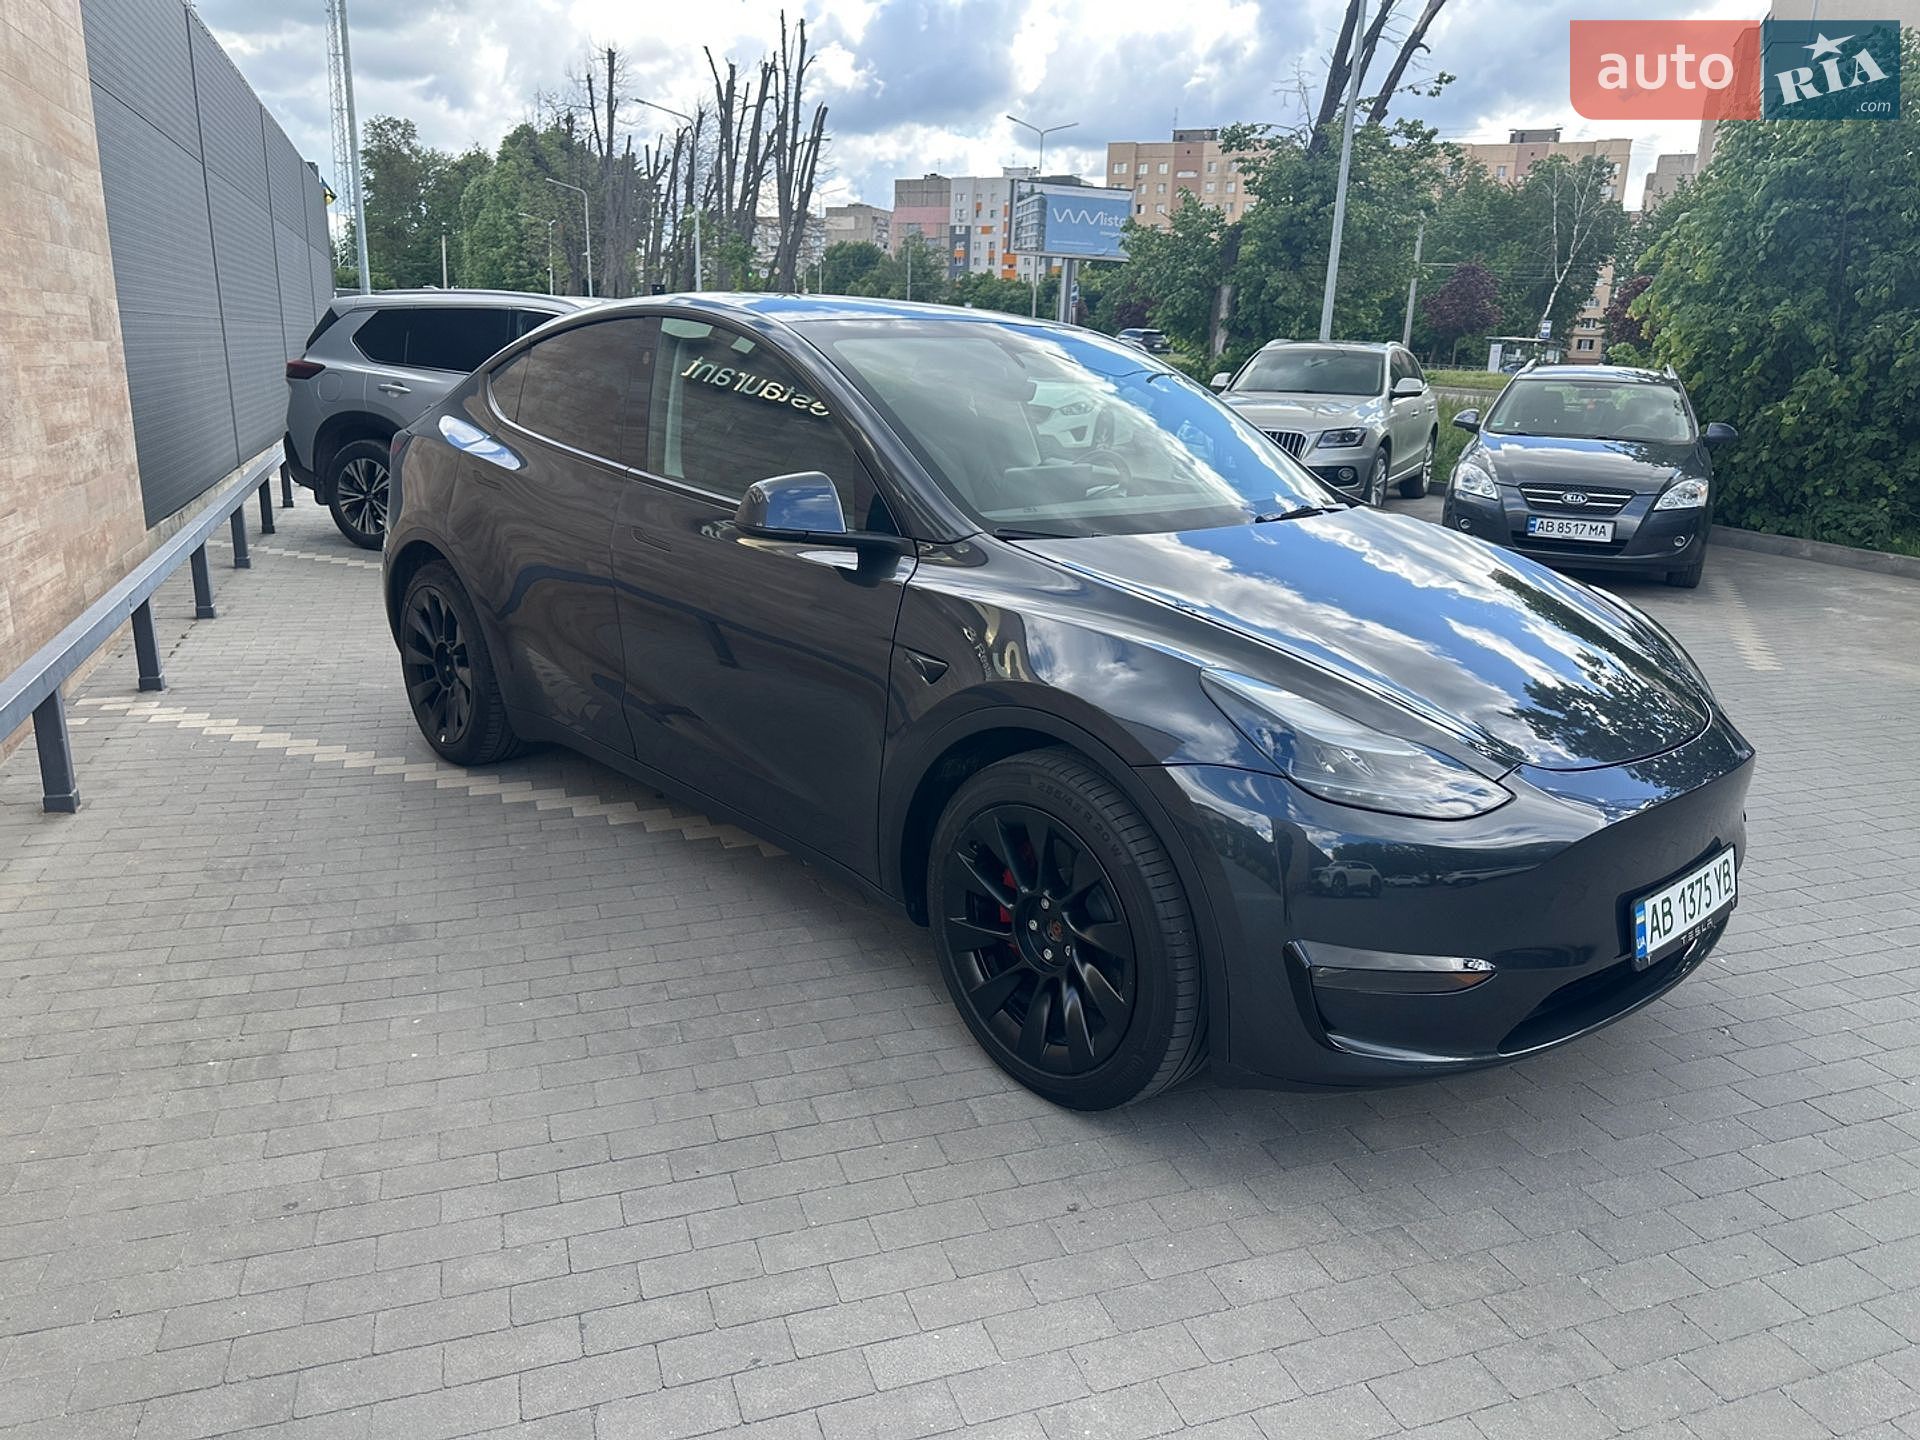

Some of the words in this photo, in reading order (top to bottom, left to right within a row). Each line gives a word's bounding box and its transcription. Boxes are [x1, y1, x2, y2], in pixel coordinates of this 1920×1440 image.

[1566, 492, 1585, 504] KIA
[1536, 520, 1555, 533] AB
[1557, 522, 1587, 535] 8517
[1588, 524, 1607, 537] MA
[1649, 896, 1674, 944] AB
[1678, 871, 1713, 924] 1375
[1713, 858, 1732, 901] YB
[1680, 917, 1714, 945] TESLA
